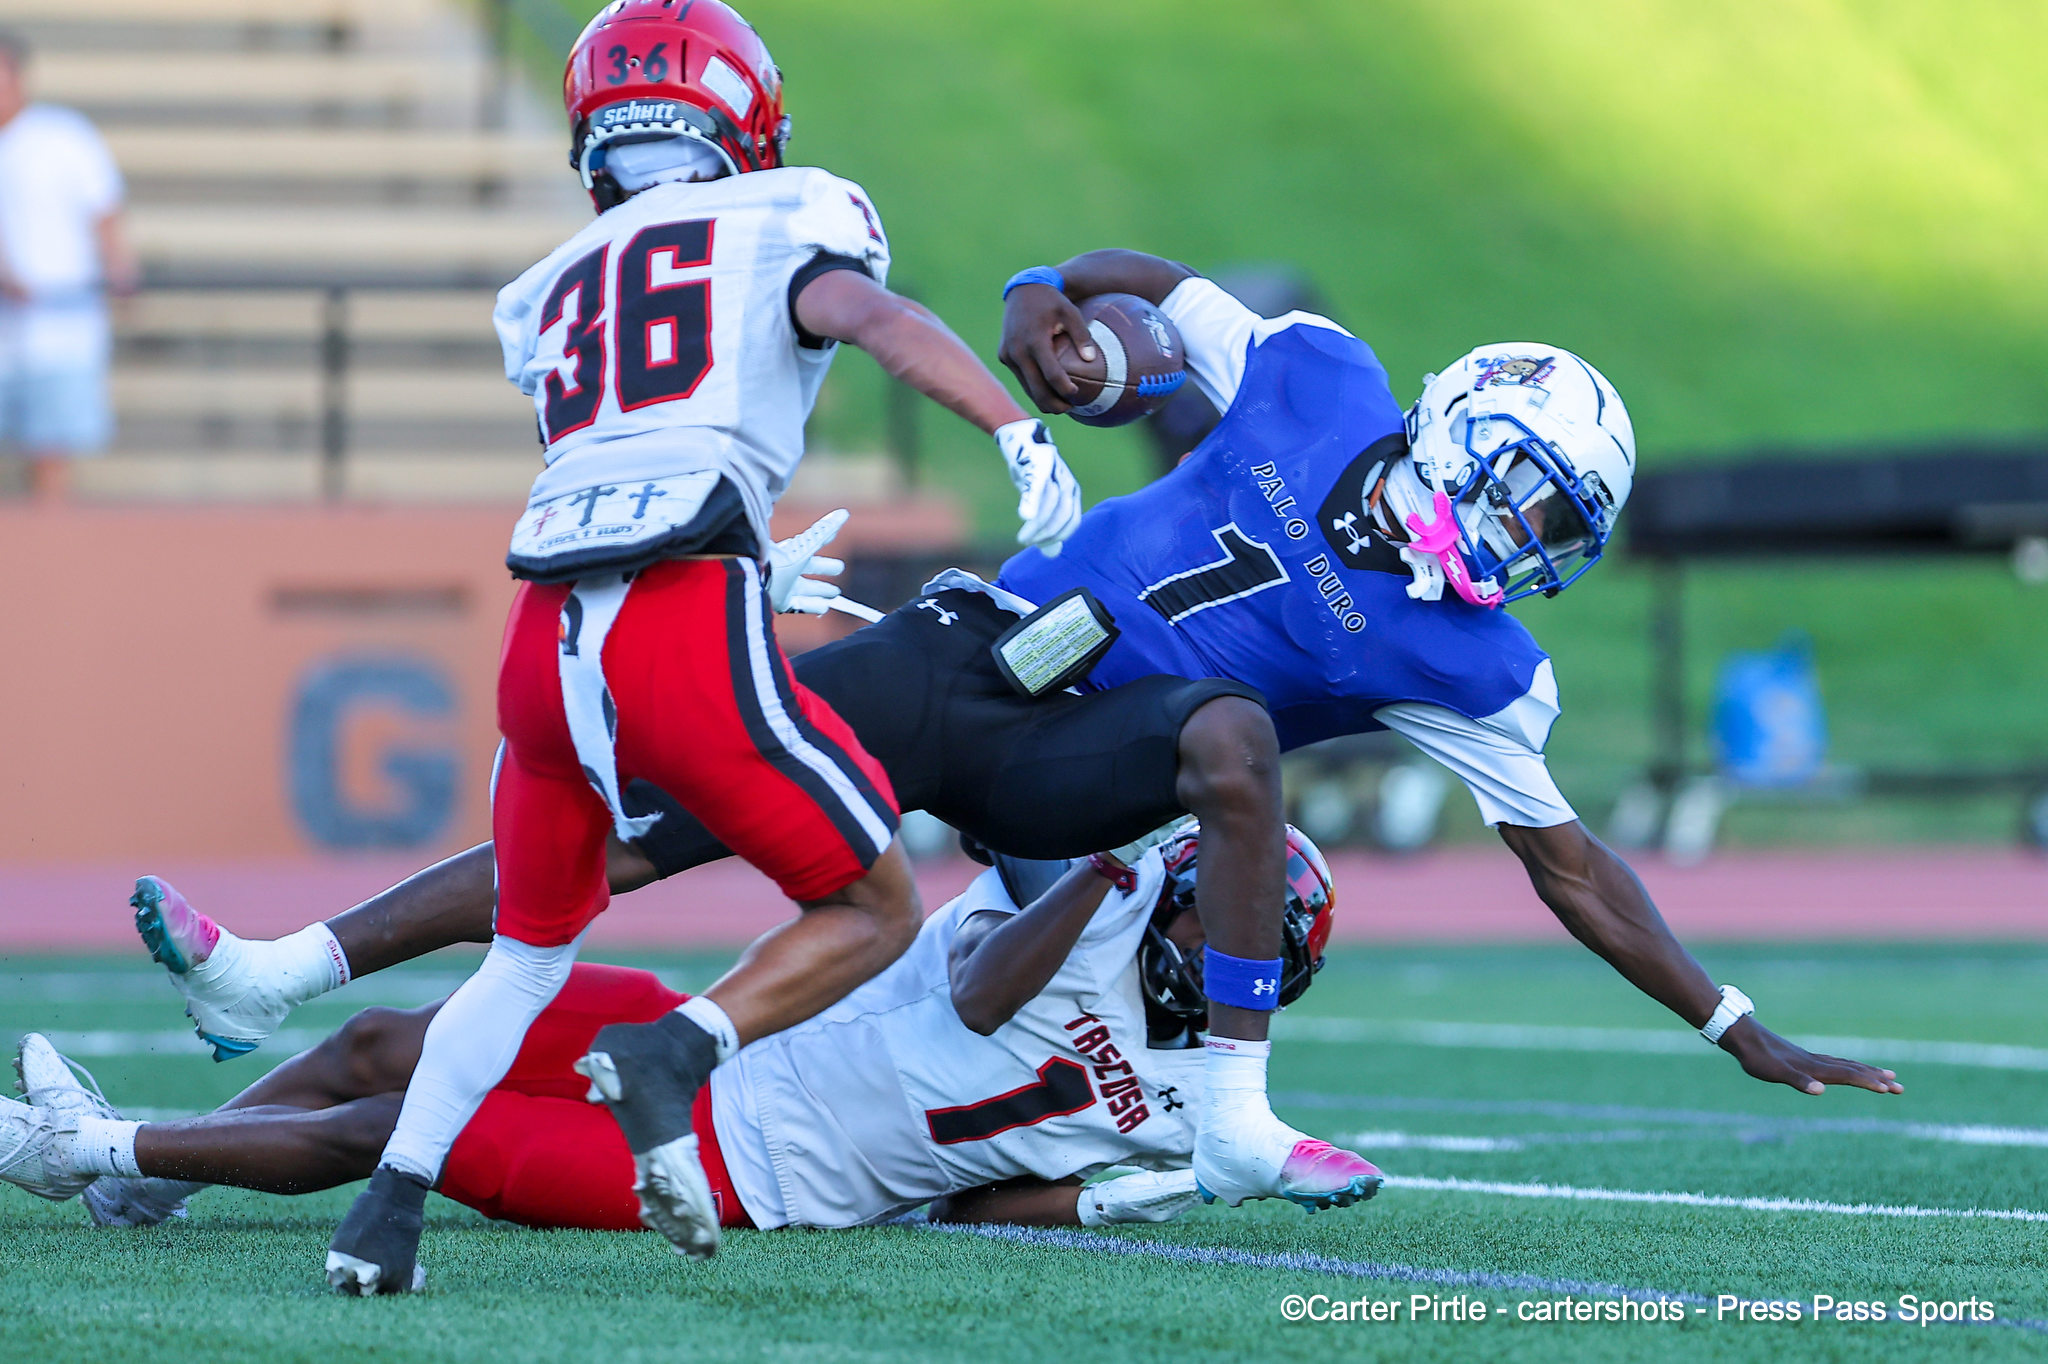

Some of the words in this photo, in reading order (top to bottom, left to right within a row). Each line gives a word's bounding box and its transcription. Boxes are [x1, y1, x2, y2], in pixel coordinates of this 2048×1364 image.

[604, 101, 676, 125] schutt
[606, 42, 669, 85] 36
[539, 218, 717, 442] 36
[1137, 521, 1291, 627] 1
[1251, 461, 1309, 540] PALO
[1303, 553, 1366, 633] DURO
[288, 654, 458, 851] G
[925, 1055, 1097, 1145] 1
[1064, 1014, 1150, 1134] TASCOSA
